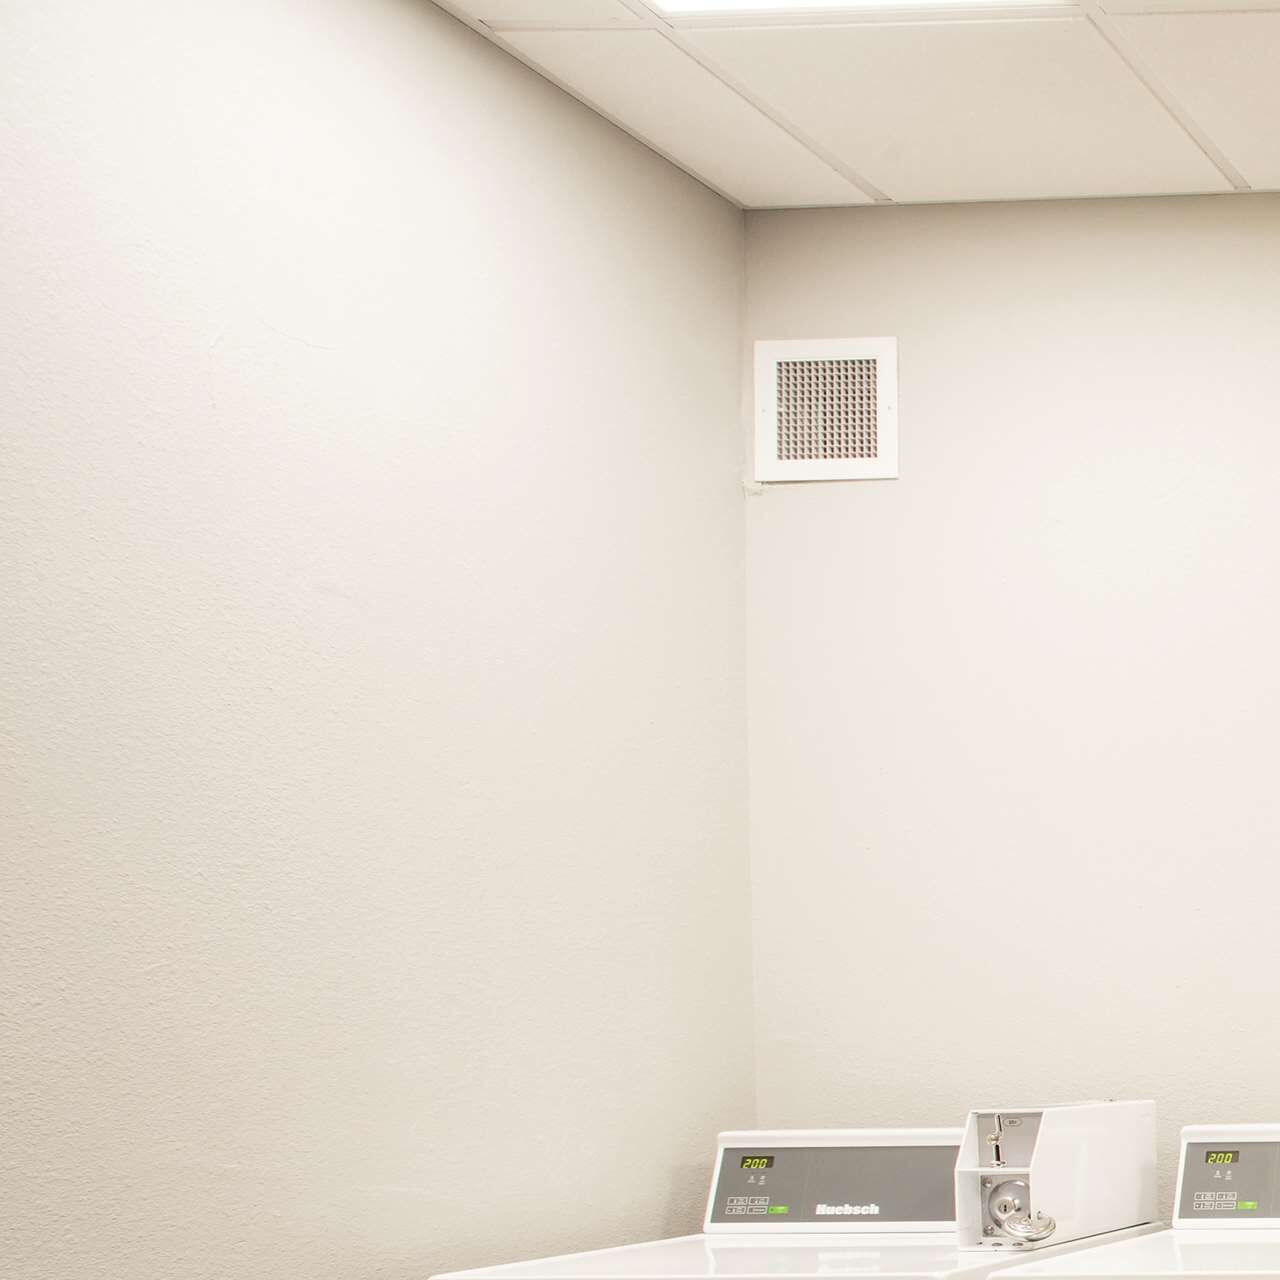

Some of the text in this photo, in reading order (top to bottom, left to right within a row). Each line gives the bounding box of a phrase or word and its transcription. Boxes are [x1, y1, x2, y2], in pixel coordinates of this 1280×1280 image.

[742, 1158, 768, 1169] 200
[1208, 1153, 1233, 1164] 200
[815, 1203, 880, 1215] Huebsch
